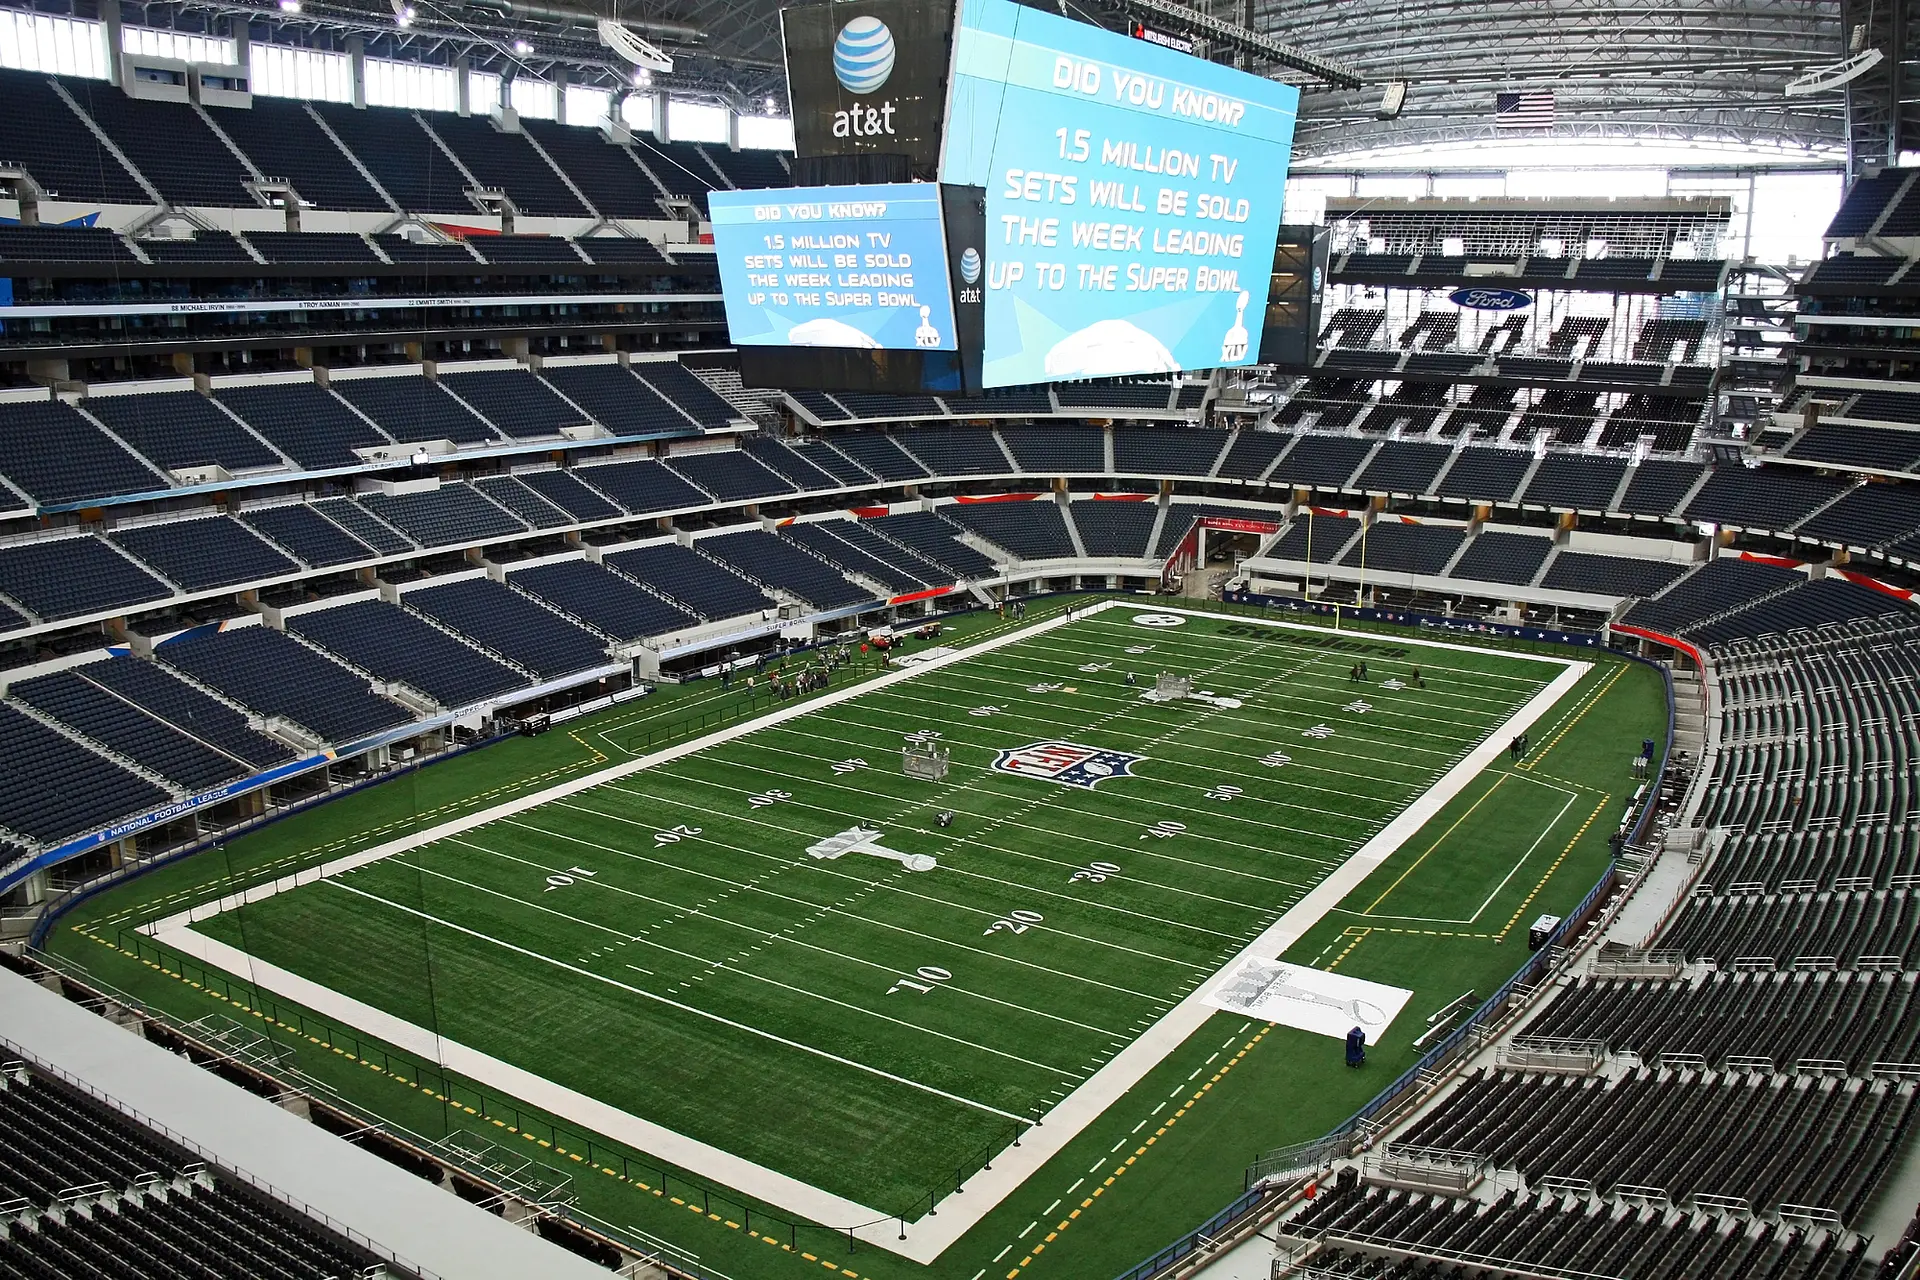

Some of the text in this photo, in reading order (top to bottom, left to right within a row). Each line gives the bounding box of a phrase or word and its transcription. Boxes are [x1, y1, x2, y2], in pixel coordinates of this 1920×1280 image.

[1170, 37, 1193, 54] ELECTRIC
[1053, 56, 1245, 127] DID YOU KNOW?
[833, 101, 896, 137] at&t
[1056, 127, 1238, 184] 1.5 MILLION TV
[1004, 168, 1250, 223] SETS WILL BE SOLD
[754, 203, 887, 220] DID YOU KNOW?
[764, 233, 892, 250] 1.5 MILLION TV
[1001, 215, 1244, 258] THE WEEK LEADING
[745, 254, 912, 269] SETS WILL BE SOLD
[748, 273, 914, 288] THE WEEK LEADING
[988, 261, 1024, 290] UP
[1035, 262, 1066, 291] TO
[1077, 264, 1118, 291] THE
[319, 300, 341, 308] AIKMAN
[748, 293, 766, 306] UP
[770, 293, 788, 306] TO
[793, 293, 820, 306] THE
[960, 287, 981, 303] at&t
[1465, 290, 1516, 308] Ford
[180, 303, 208, 311] MICHAEL
[1220, 345, 1249, 362] XLV
[1217, 624, 1411, 658] Steelers
[748, 789, 793, 806] 30
[1203, 785, 1244, 801] 50
[110, 788, 228, 836] NATIONAL FOOTBALL LEAGUE
[654, 824, 703, 843] 20
[1147, 821, 1187, 838] 40
[545, 866, 598, 886] 10
[1074, 862, 1121, 883] 30
[991, 910, 1044, 935] 20
[896, 966, 953, 994] 10
